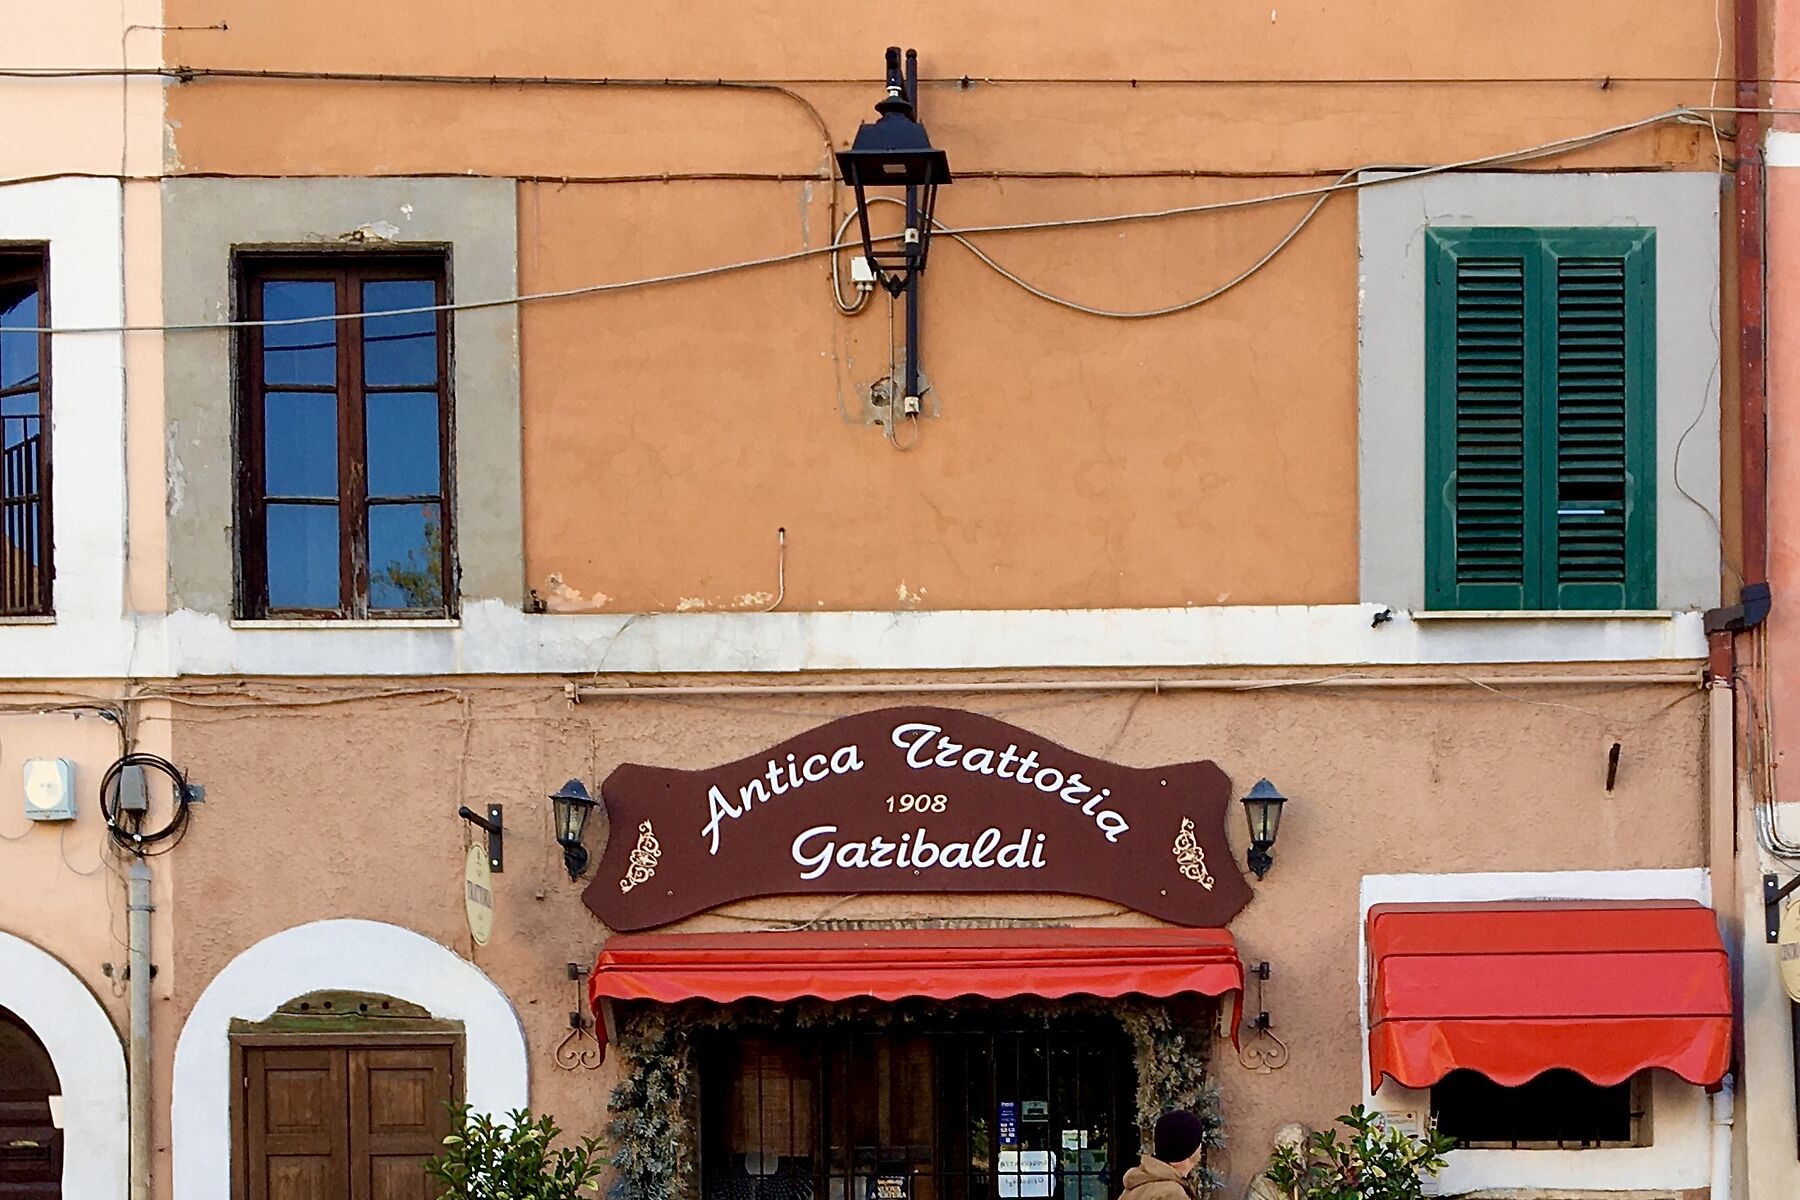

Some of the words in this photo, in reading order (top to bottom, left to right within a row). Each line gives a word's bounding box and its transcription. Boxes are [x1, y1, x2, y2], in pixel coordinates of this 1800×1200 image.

[701, 744, 866, 856] Antica
[891, 722, 1131, 843] Trattoria
[886, 793, 949, 813] 1908
[791, 825, 1047, 881] Garibaldi
